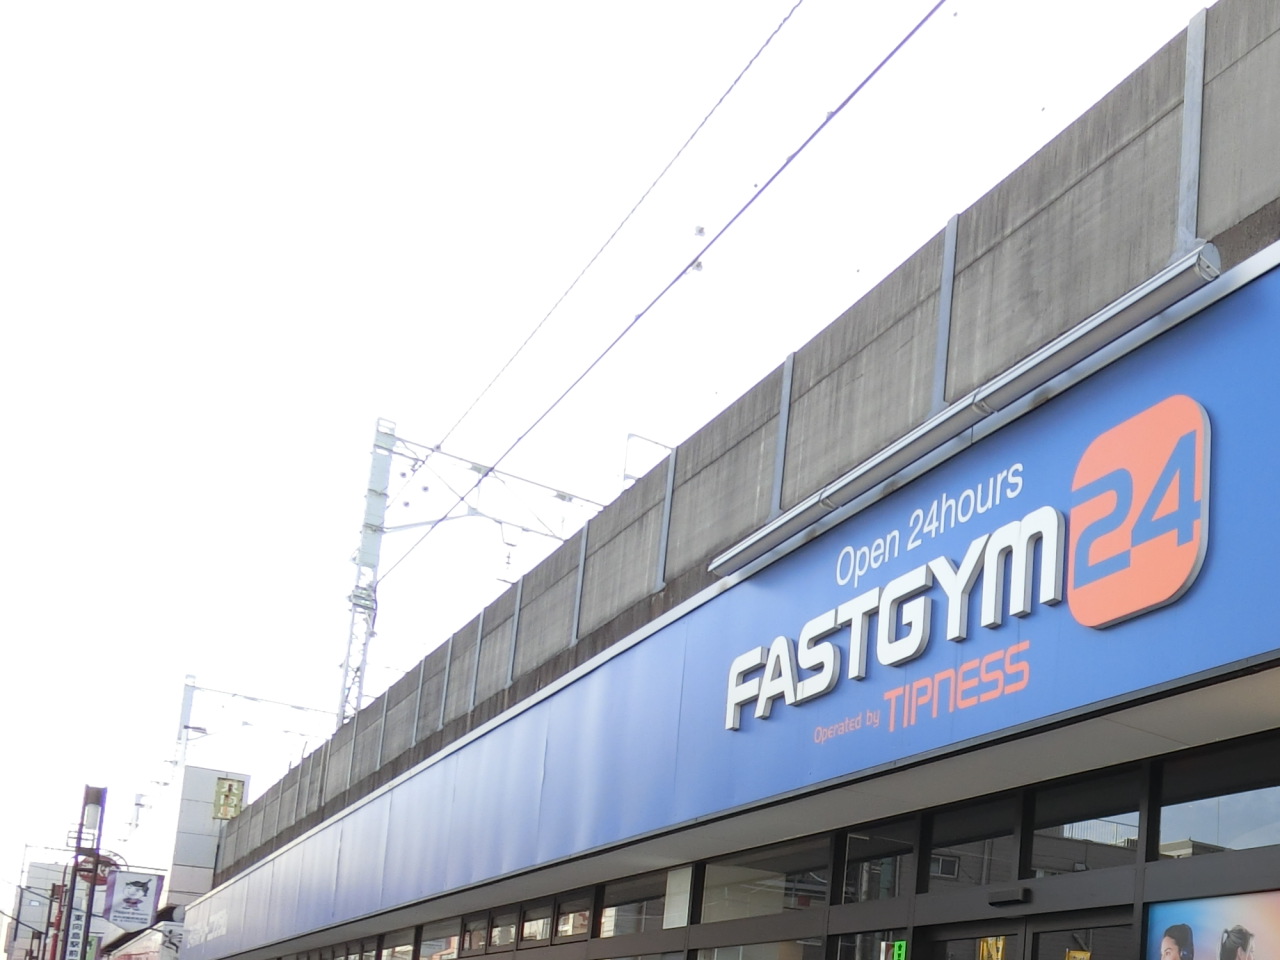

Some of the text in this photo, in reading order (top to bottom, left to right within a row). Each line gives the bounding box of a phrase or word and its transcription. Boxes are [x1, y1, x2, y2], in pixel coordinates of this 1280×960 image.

[725, 430, 1203, 732] FASTGYM 24
[836, 462, 1025, 589] Open 24hours
[813, 640, 1031, 744] Operated by TIPNESS
